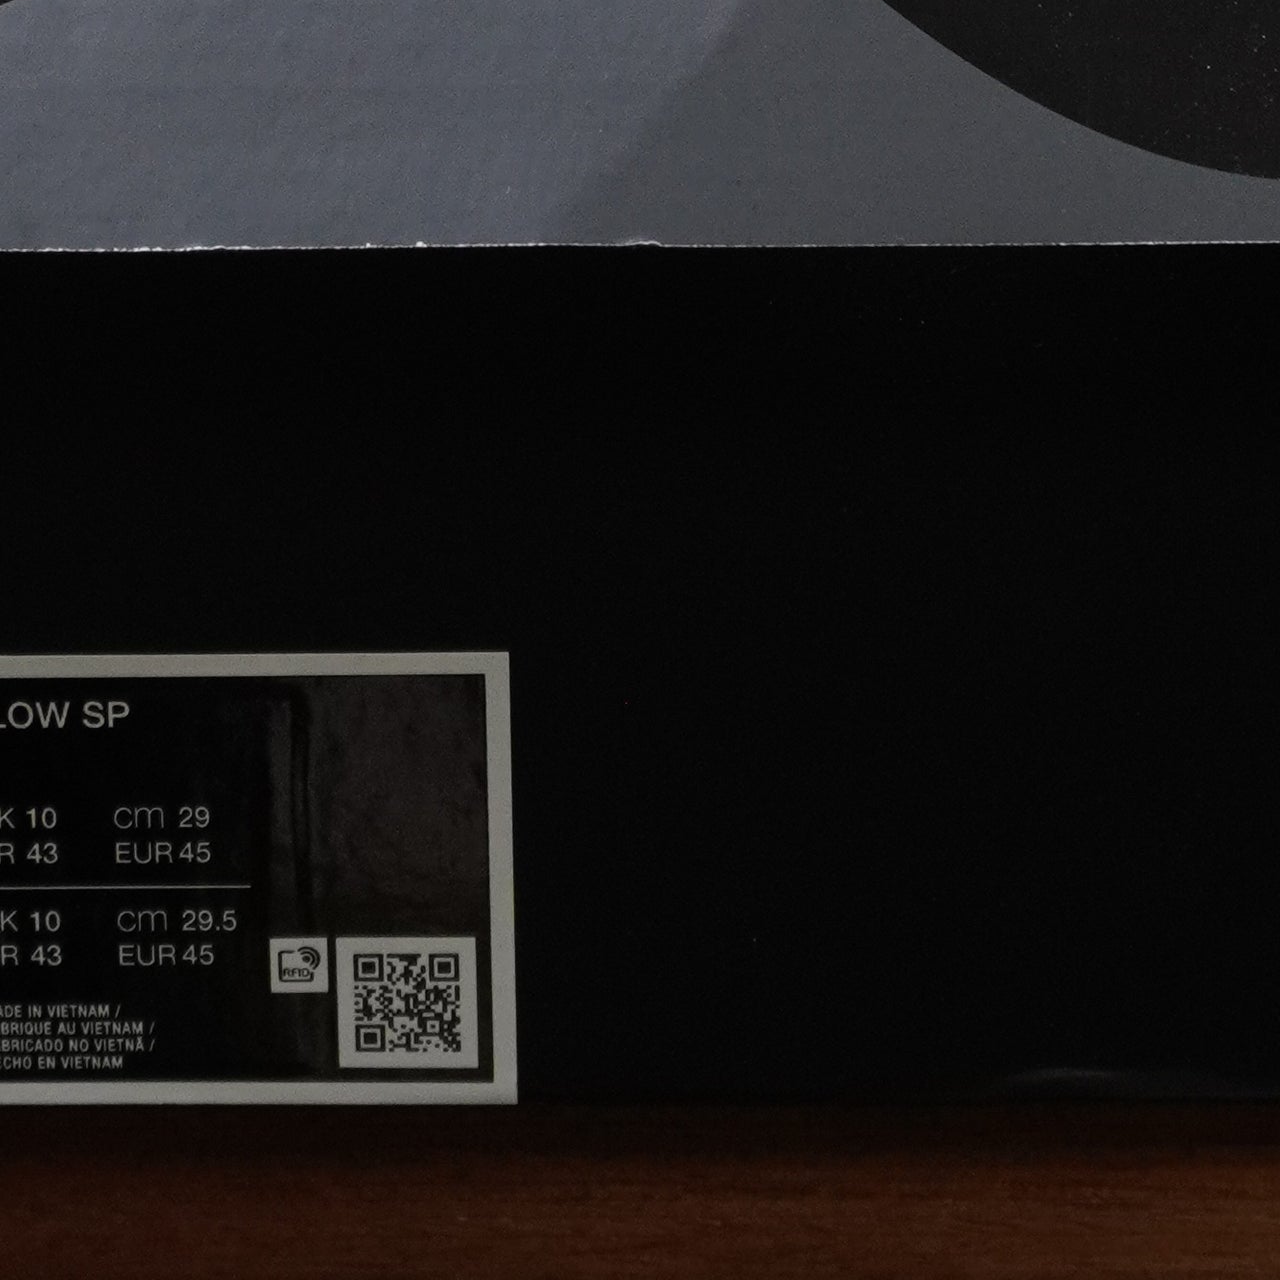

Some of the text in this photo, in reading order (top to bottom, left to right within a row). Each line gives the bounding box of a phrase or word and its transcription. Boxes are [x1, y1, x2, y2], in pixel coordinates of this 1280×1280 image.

[82, 700, 130, 729] SP
[26, 806, 57, 829] 10
[113, 805, 210, 830] cm 29
[26, 841, 59, 865] 43
[115, 841, 212, 865] EUR 45
[30, 910, 61, 933] 10
[116, 909, 238, 933] cm 29.5
[30, 944, 63, 967] 43
[118, 943, 215, 967] EUR 45
[27, 1004, 42, 1018] IN
[47, 1004, 110, 1018] VIETNAM
[57, 1021, 76, 1036] AU
[80, 1021, 144, 1035] VIETNAM
[68, 1038, 90, 1053] NO
[37, 1055, 56, 1070] EN
[60, 1055, 123, 1070] VIETNAM
